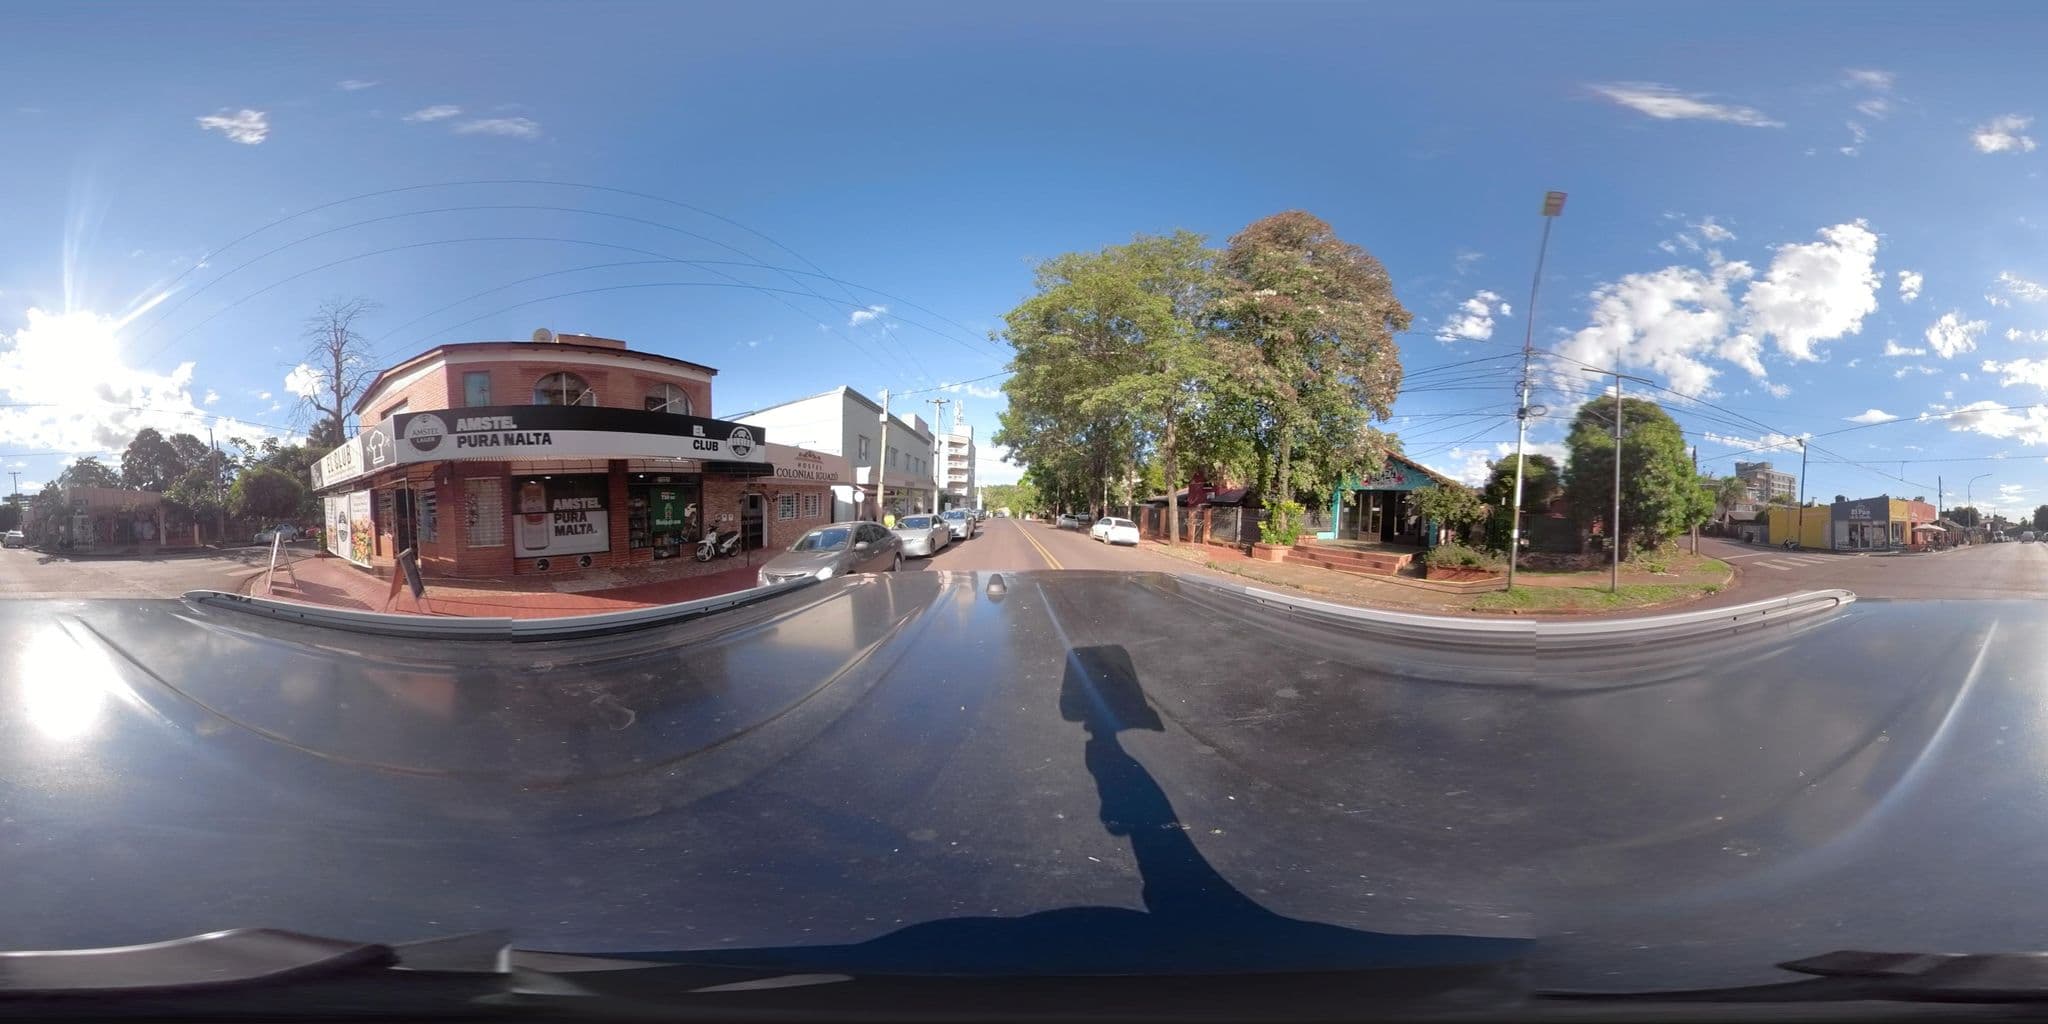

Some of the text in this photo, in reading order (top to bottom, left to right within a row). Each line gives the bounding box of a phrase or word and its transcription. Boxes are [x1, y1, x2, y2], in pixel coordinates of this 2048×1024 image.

[456, 416, 517, 431] AMSTEL
[412, 428, 440, 436] AMSTEL
[693, 425, 705, 436] EL
[457, 434, 499, 448] PURA
[693, 439, 719, 451] CLUB
[776, 467, 814, 480] COLONIAL
[553, 497, 602, 511] AMSTEL
[554, 511, 587, 524] PURA
